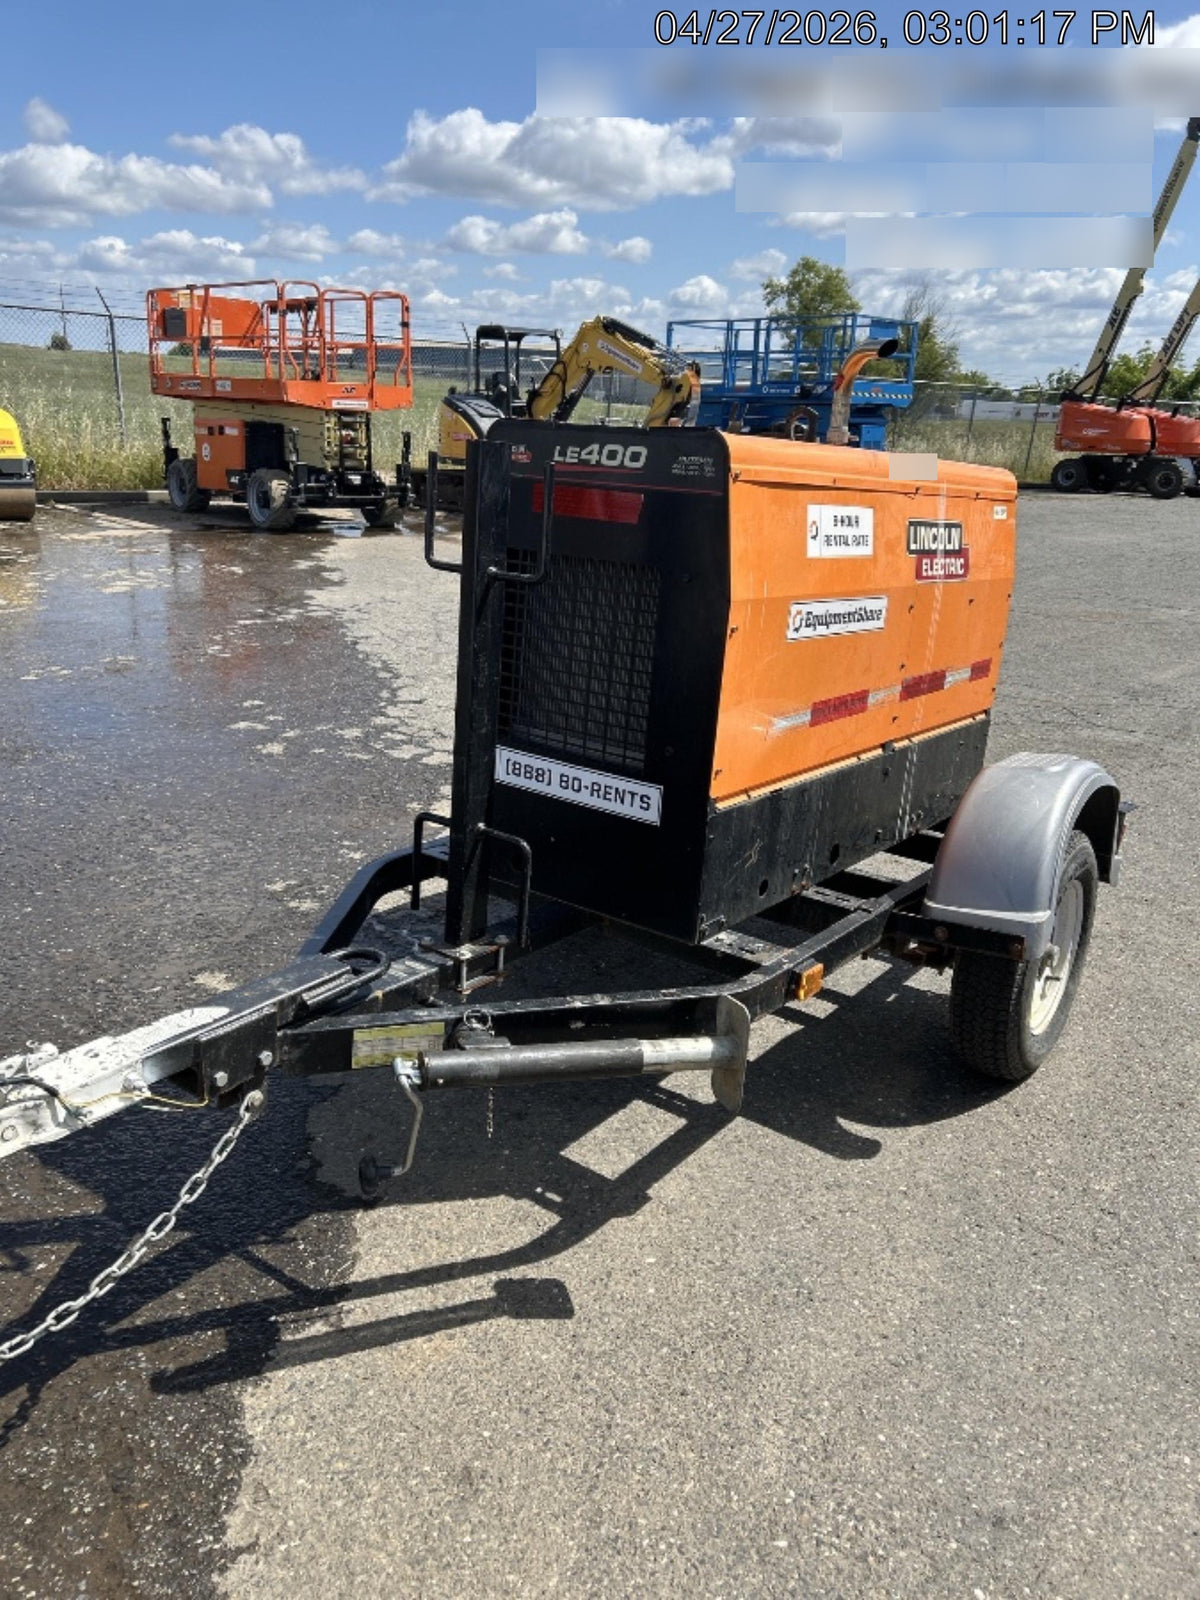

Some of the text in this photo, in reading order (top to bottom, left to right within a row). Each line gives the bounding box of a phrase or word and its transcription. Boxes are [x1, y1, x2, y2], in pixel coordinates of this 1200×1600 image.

[552, 443, 648, 469] LE400
[823, 534, 850, 547] RENTAL
[909, 525, 961, 550] LINCOLN
[921, 557, 965, 577] ELECTRIC
[803, 607, 883, 631] EquipmentShare
[559, 773, 652, 812] 80-RENTS
